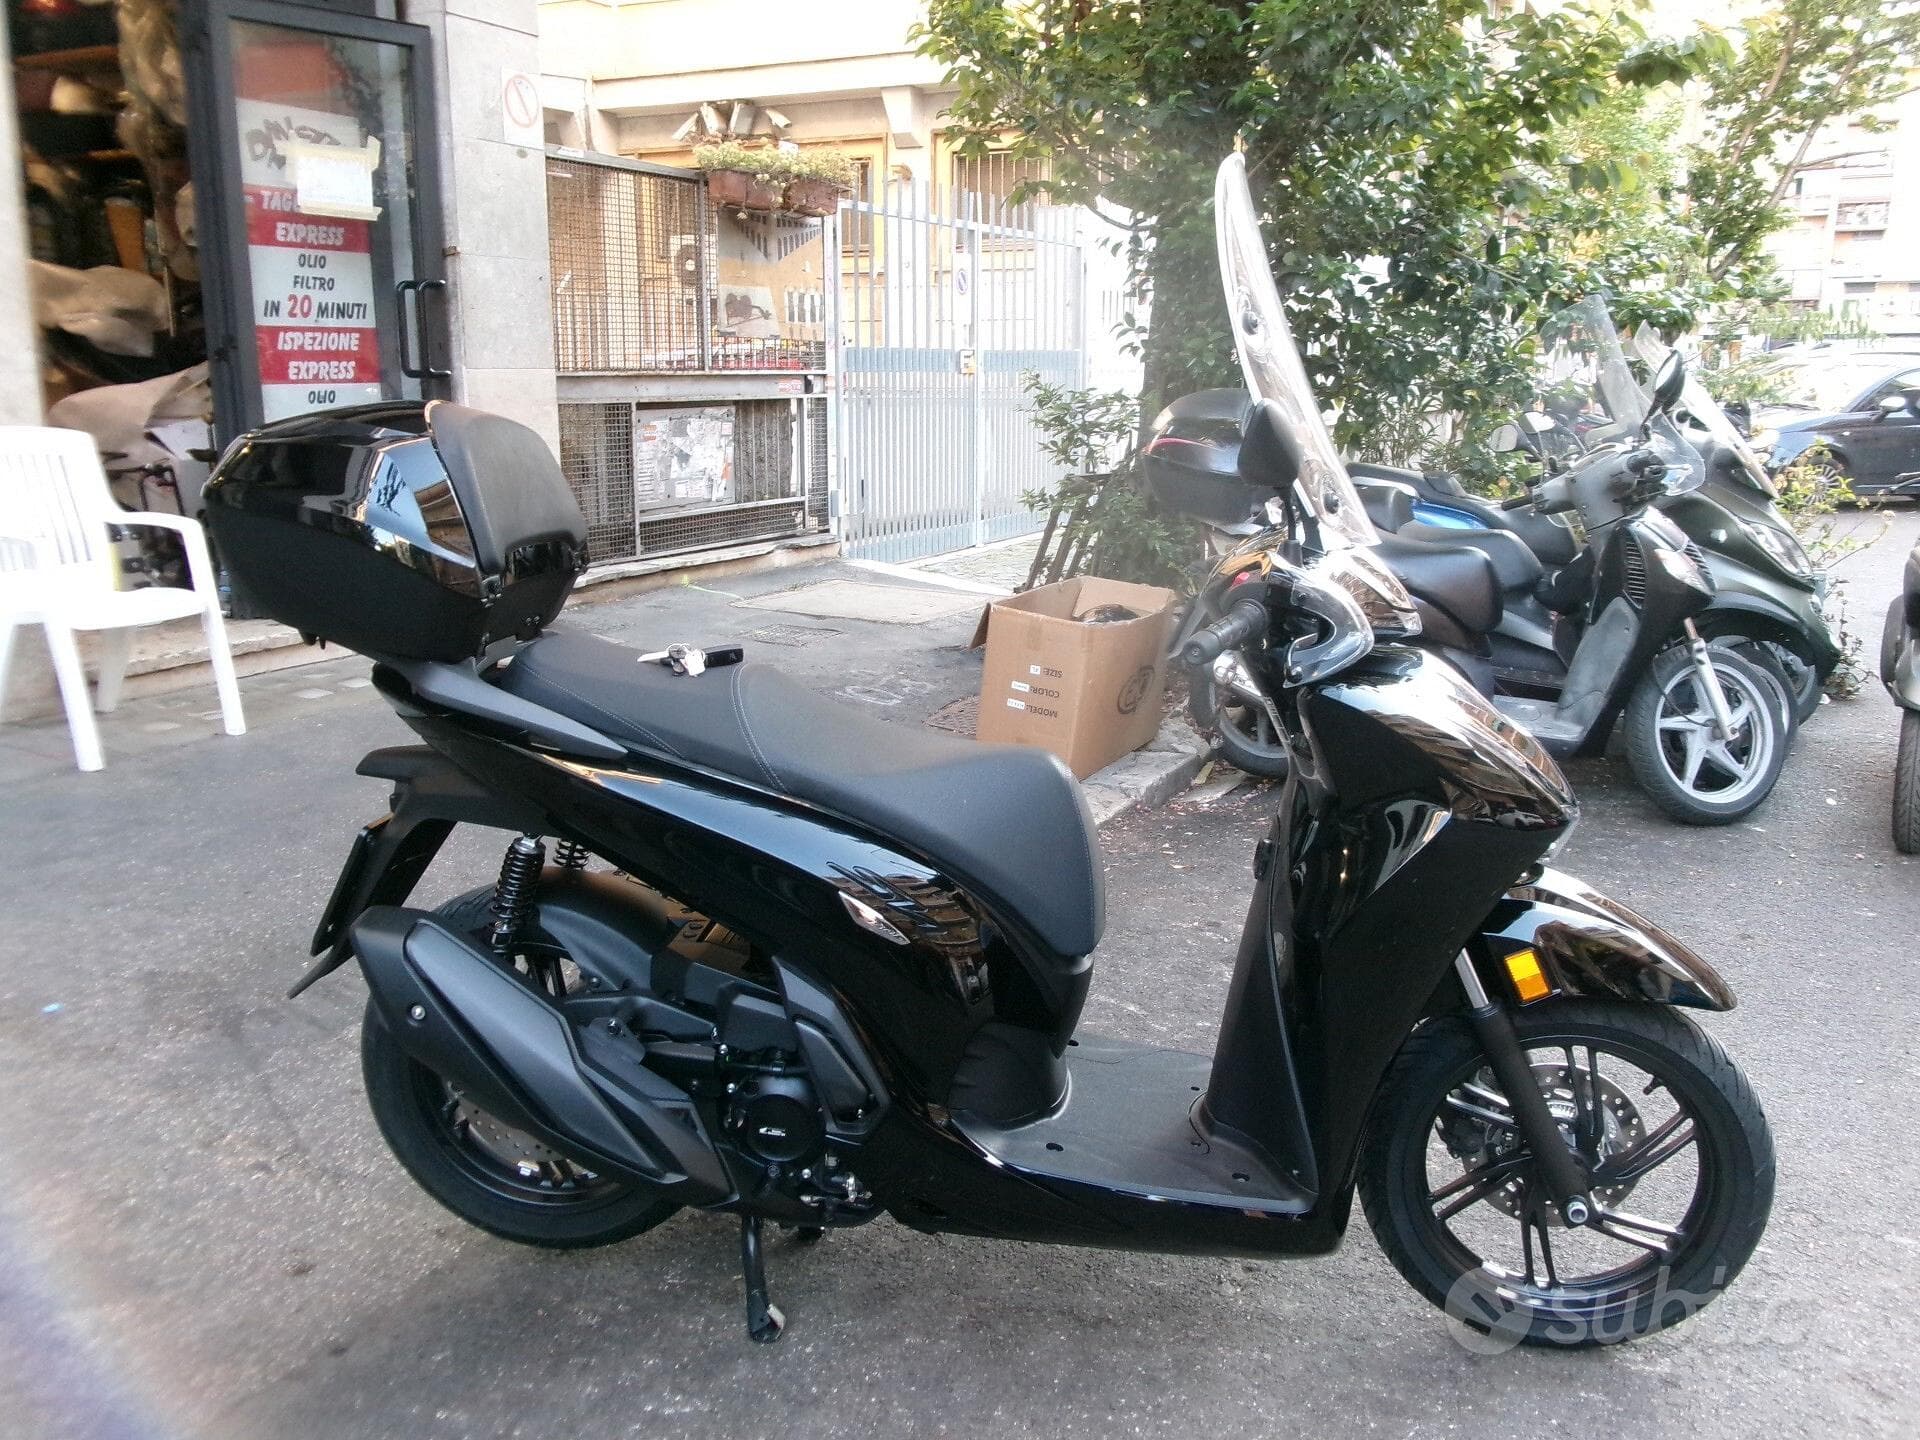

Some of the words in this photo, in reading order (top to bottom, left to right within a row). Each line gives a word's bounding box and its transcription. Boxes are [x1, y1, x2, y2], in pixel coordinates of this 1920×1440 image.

[276, 222, 344, 246] EXPRESS
[298, 253, 326, 269] OLIO
[293, 275, 335, 291] FILTRO
[263, 299, 280, 318] IN
[287, 294, 312, 319] 20
[316, 301, 368, 320] MINUTI
[277, 331, 361, 351] ISPEZIONE
[288, 361, 357, 381] EXPRESS
[308, 390, 336, 404] OLIO
